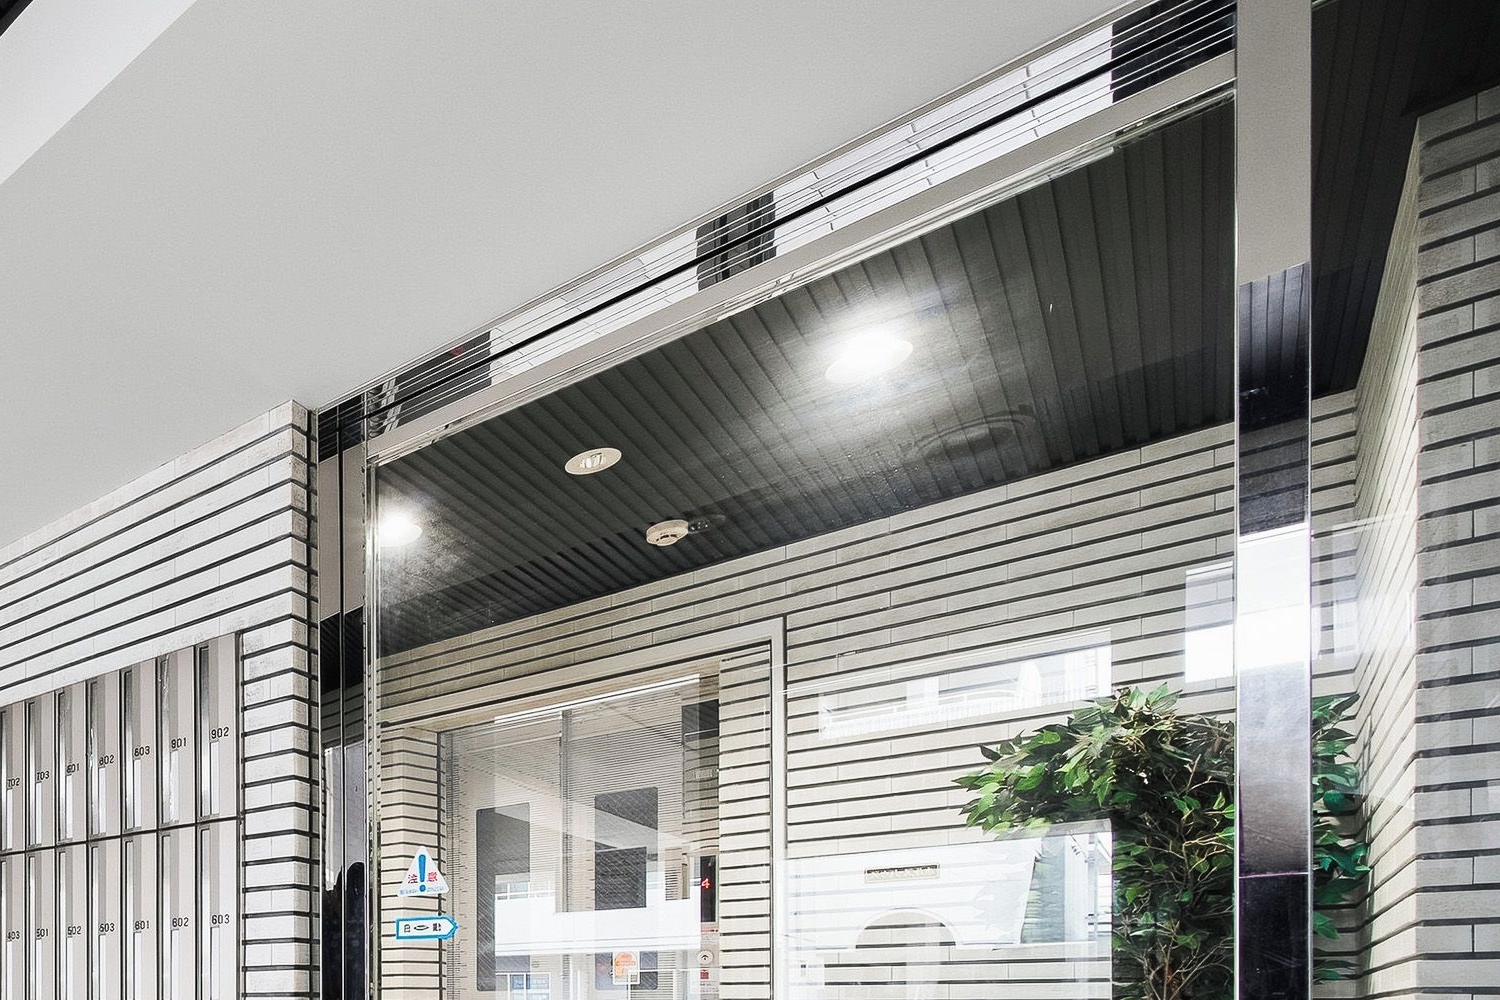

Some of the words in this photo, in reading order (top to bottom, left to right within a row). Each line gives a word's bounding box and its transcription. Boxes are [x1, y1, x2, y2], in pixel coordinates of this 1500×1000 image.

[211, 726, 230, 739] 902
[134, 745, 150, 757] 803
[66, 763, 80, 774] 801
[36, 770, 50, 780] 703
[8, 778, 20, 787] 702
[701, 877, 710, 888] 4
[212, 914, 230, 924] 603
[36, 928, 48, 938] 501
